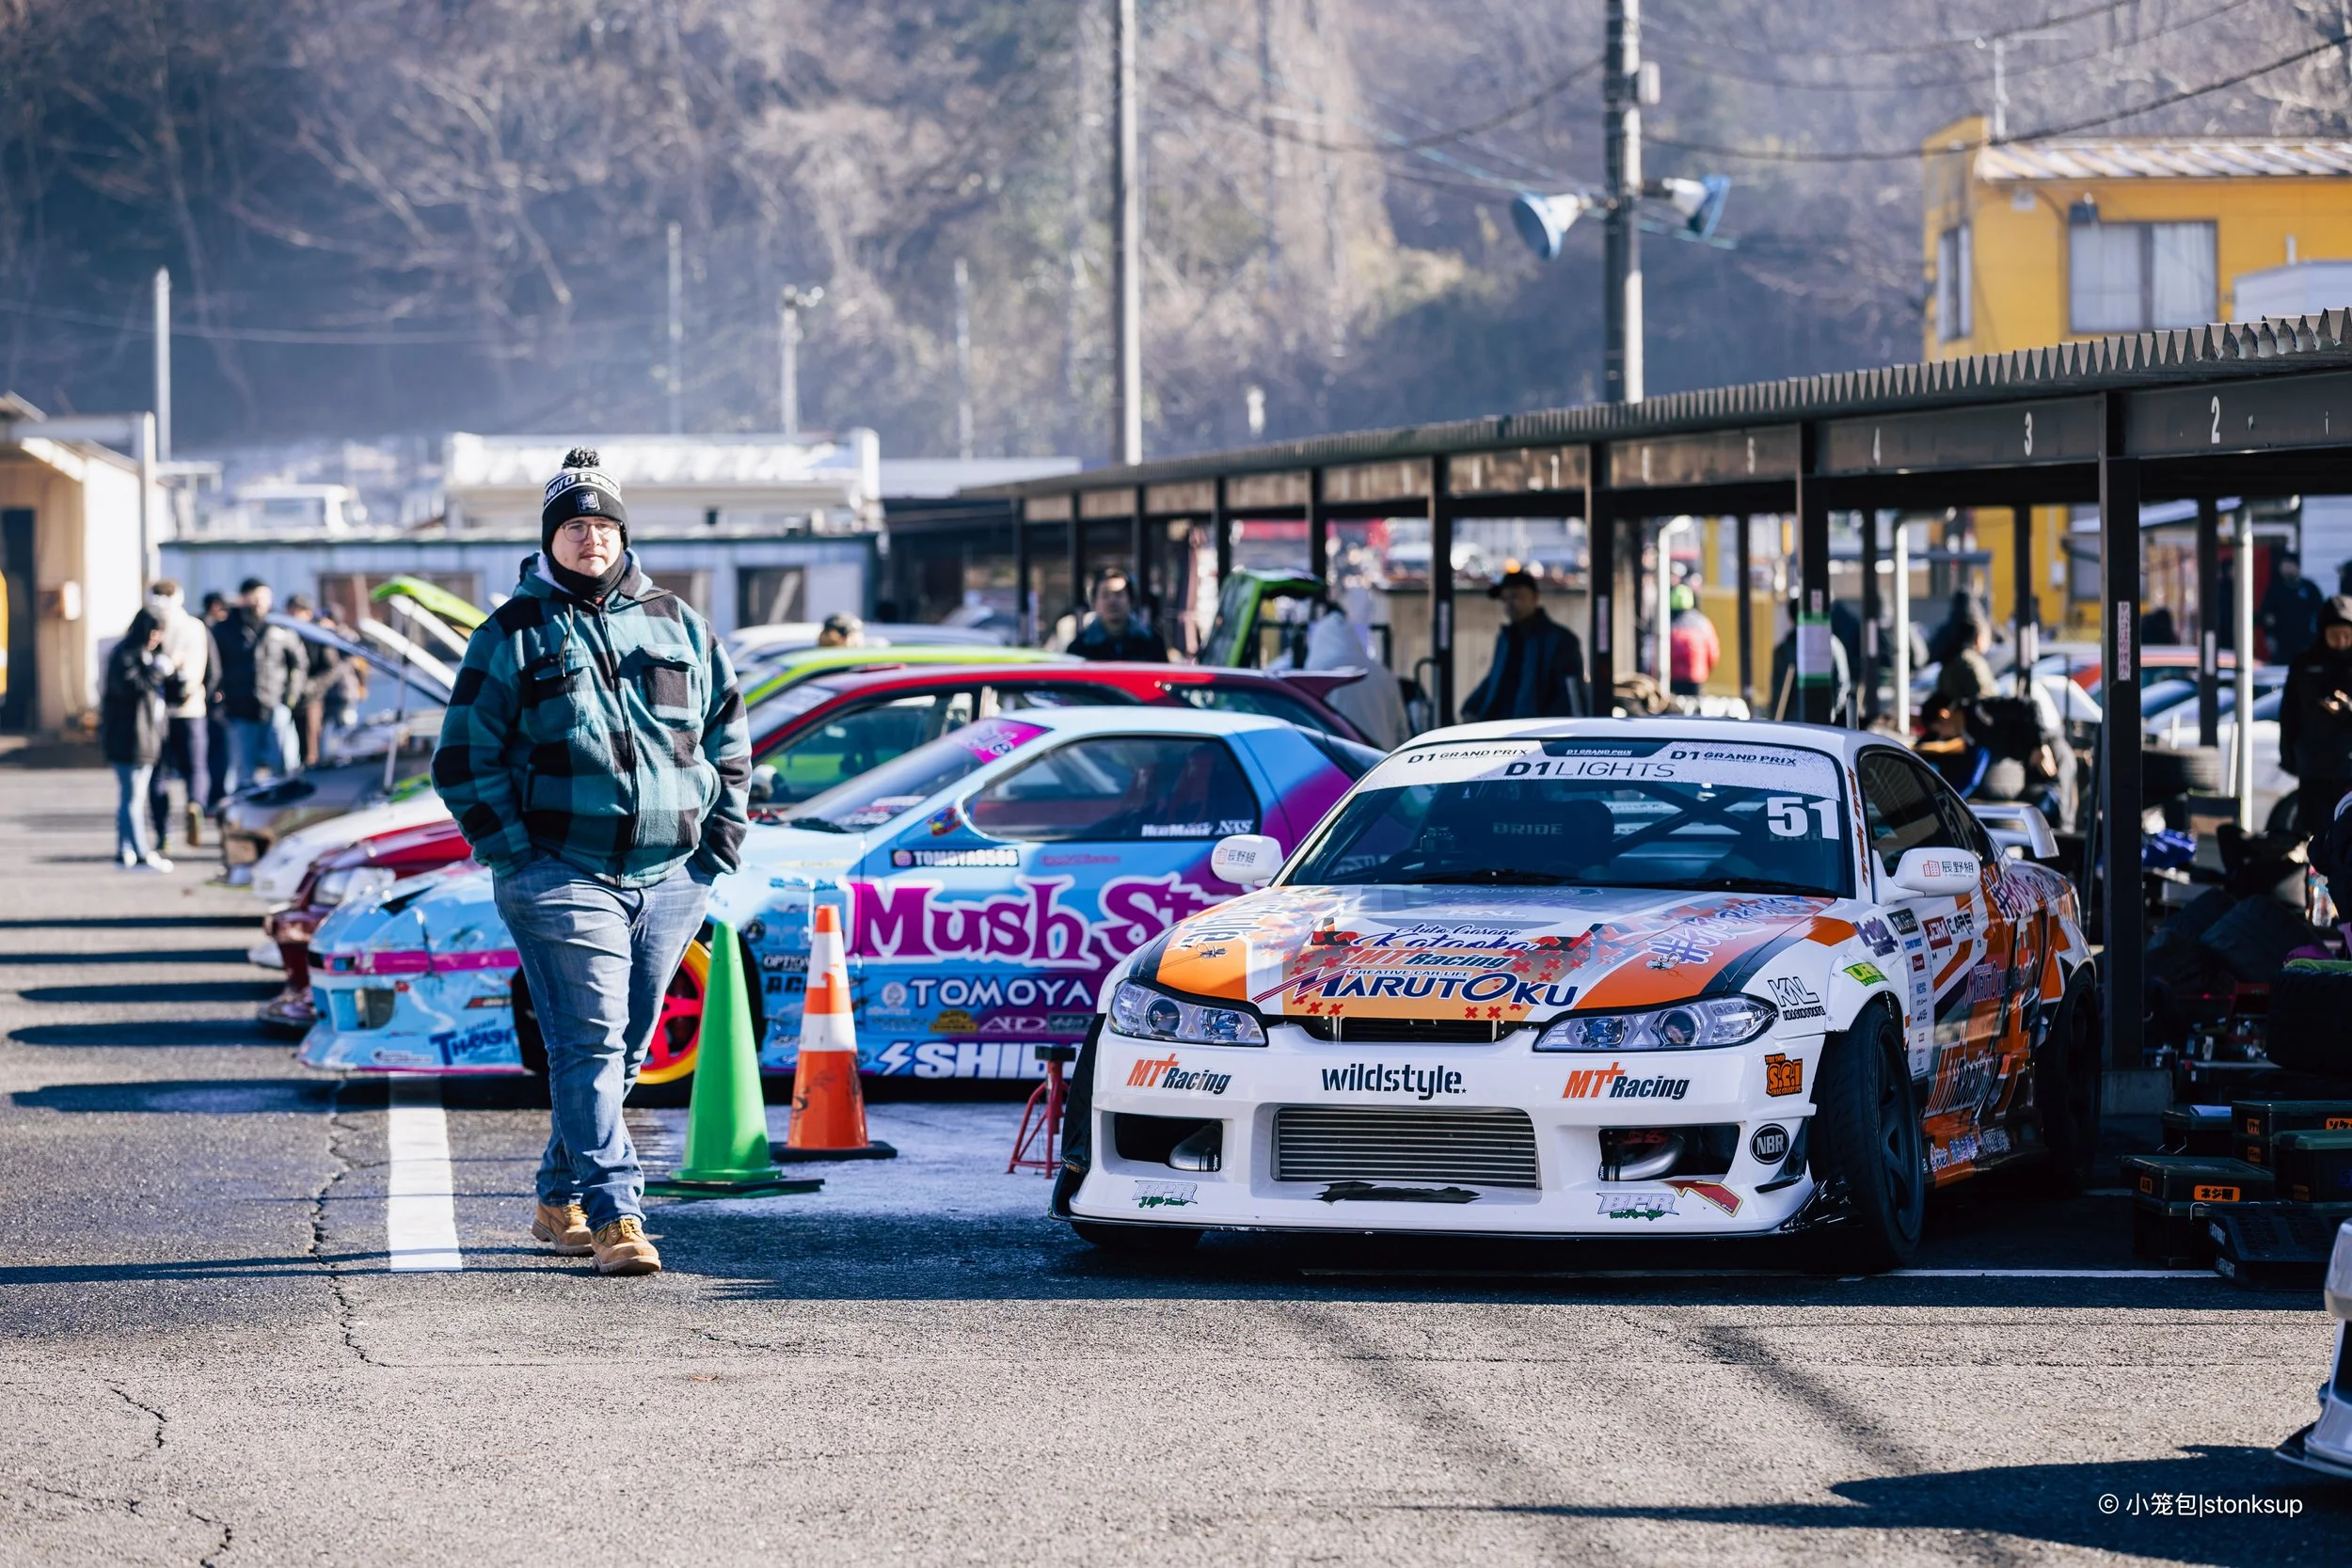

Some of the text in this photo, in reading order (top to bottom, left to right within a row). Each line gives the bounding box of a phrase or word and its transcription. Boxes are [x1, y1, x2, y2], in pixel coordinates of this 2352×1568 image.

[2211, 395, 2220, 444] 2
[2024, 411, 2033, 457] 3
[1407, 753, 1437, 764] D1
[1439, 751, 1490, 759] GRAND
[1504, 761, 1676, 778] D1 LIGHTS
[1670, 751, 1700, 760] D1
[1704, 752, 1757, 762] GRAND
[1760, 755, 1797, 765] PRIX
[1767, 797, 1840, 840] 51
[1941, 861, 1974, 874] 辰野組
[845, 878, 1096, 965] Mush
[764, 955, 810, 969] OPTIO
[1403, 951, 1511, 969] Racing
[910, 979, 1093, 1006] TOMOYA
[1281, 968, 1579, 1007] MARUTOKU
[1767, 976, 1820, 1007] KNL
[1162, 1067, 1232, 1095] Racing
[1609, 1075, 1691, 1101] Racing
[1756, 1133, 1785, 1156] NBR
[1596, 1192, 1680, 1215] BPR
